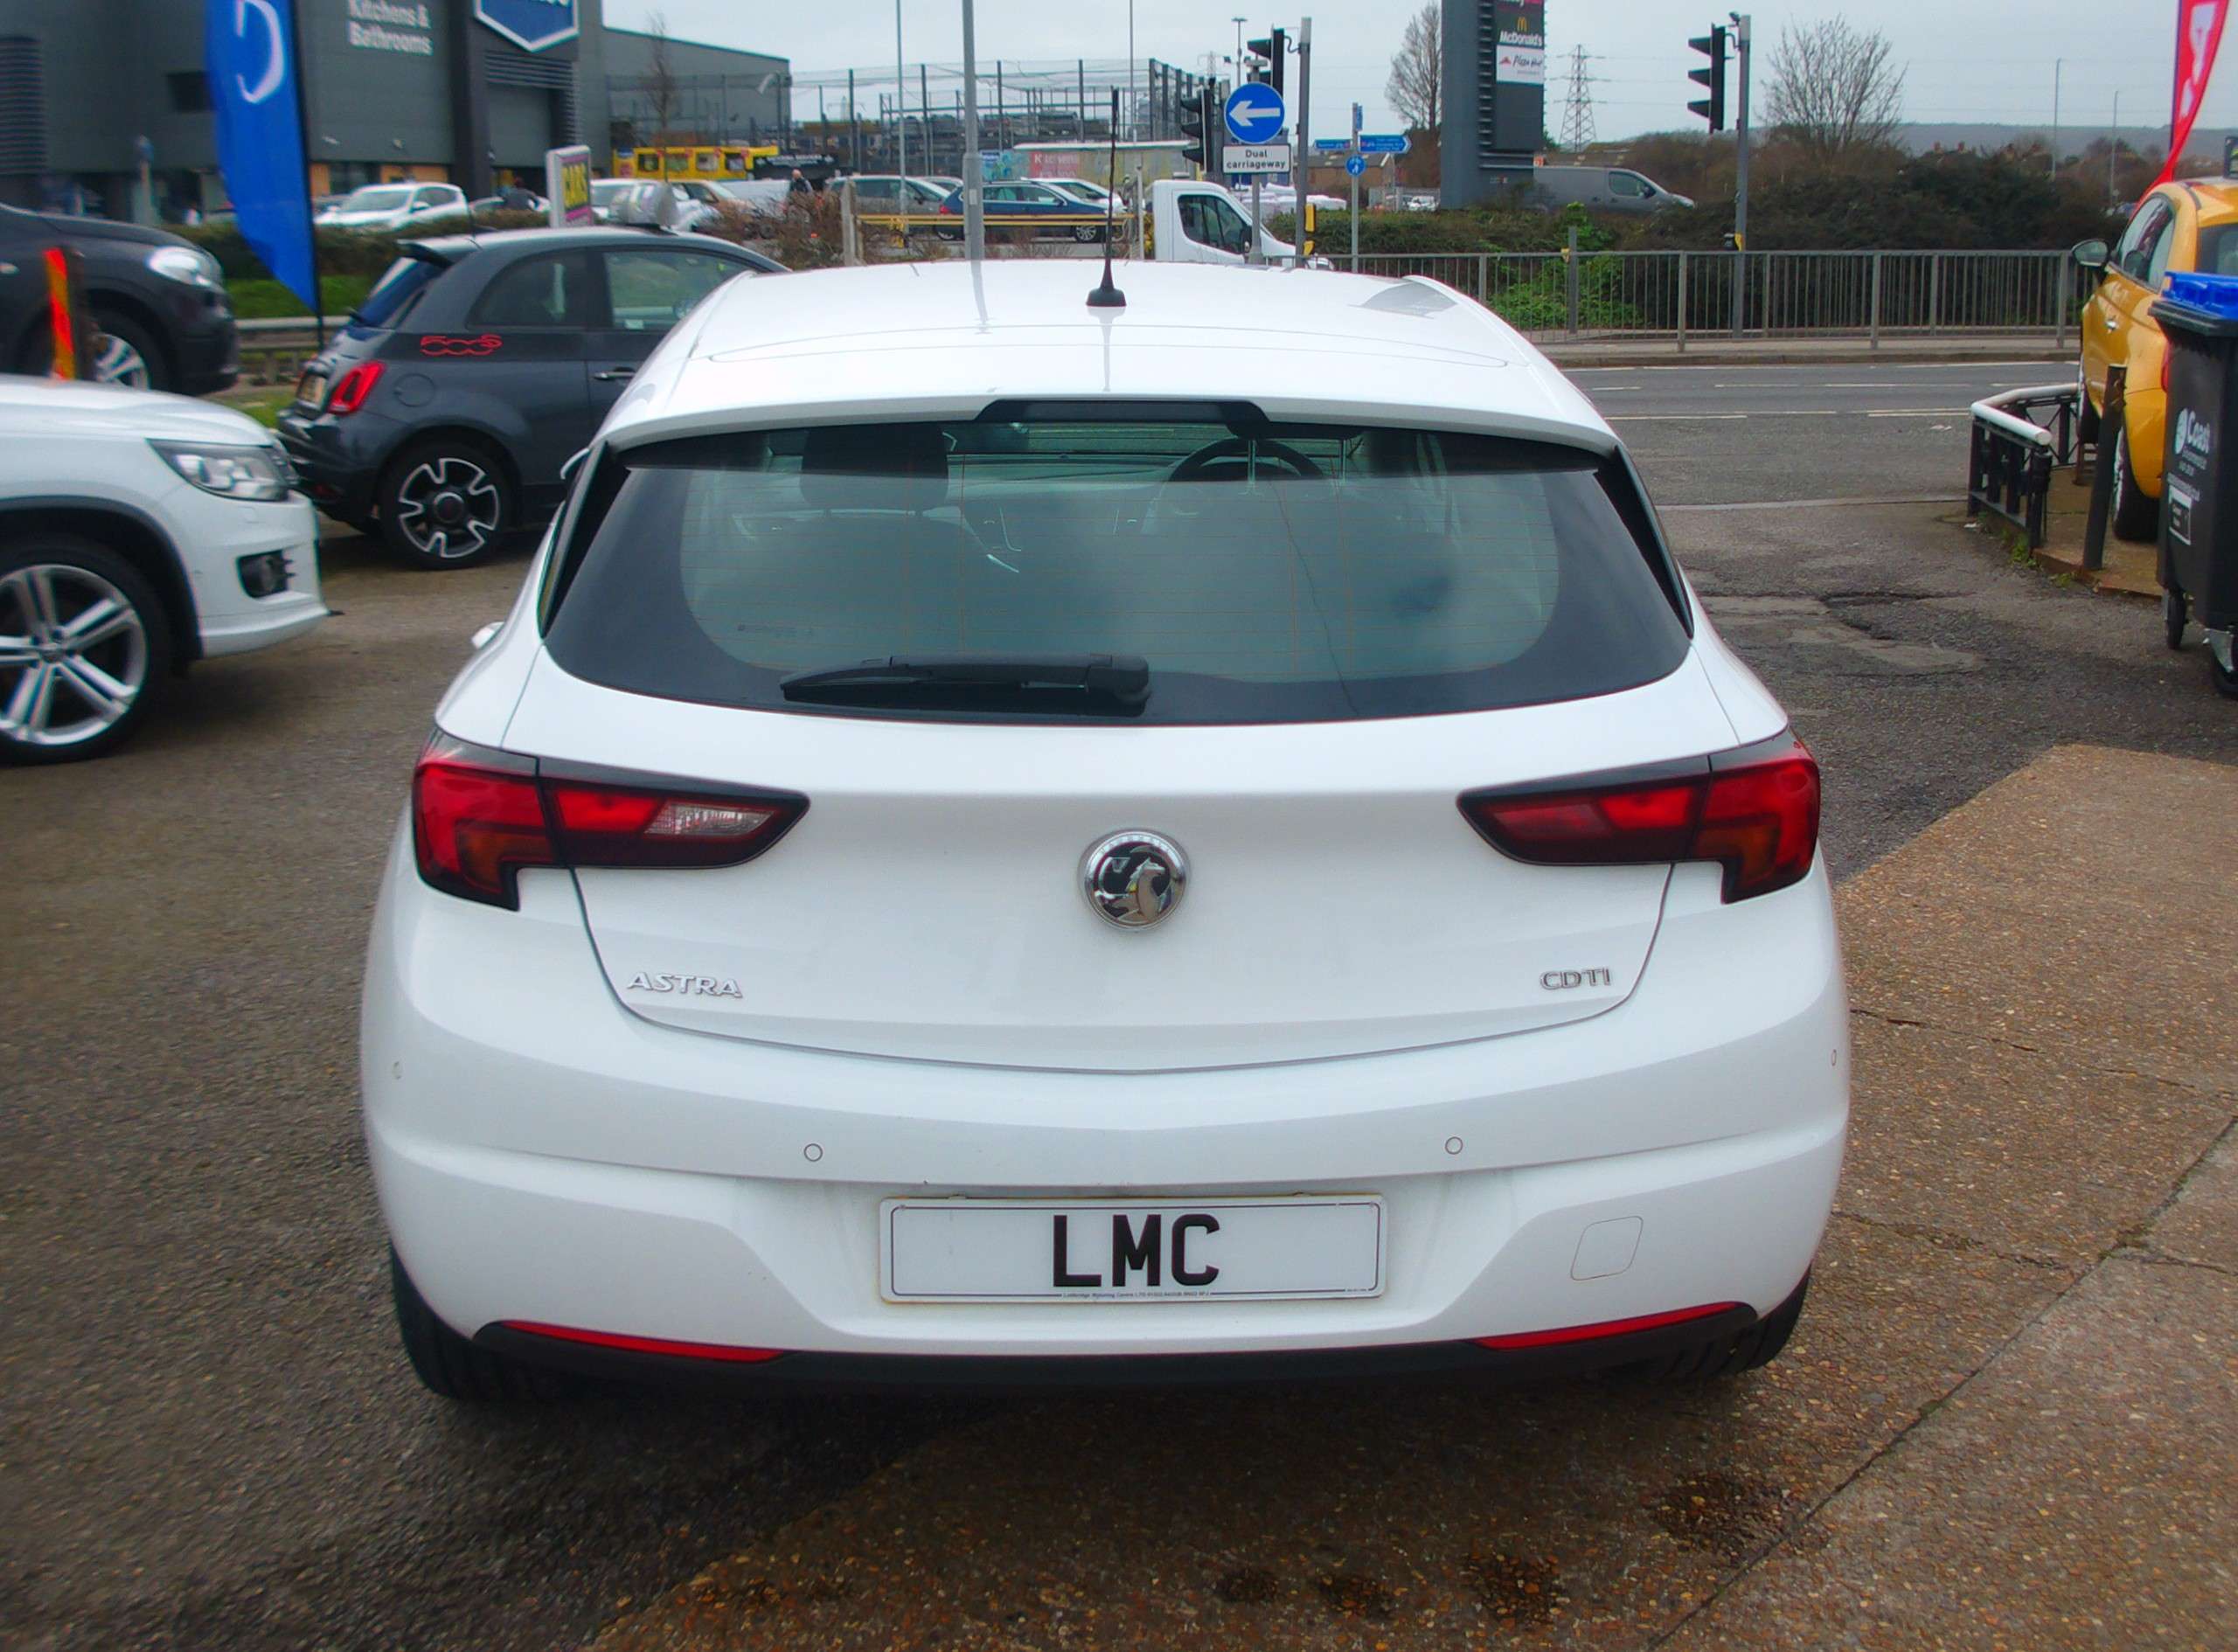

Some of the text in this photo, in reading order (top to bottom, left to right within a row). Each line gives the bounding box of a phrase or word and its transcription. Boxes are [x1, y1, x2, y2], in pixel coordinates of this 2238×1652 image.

[1499, 31, 1543, 46] McDonald's
[1245, 149, 1268, 158] Dual
[1226, 160, 1286, 170] carriageway
[627, 971, 743, 998] ASTRA
[1539, 967, 1611, 990] CDTI
[1053, 1214, 1220, 1287] LMC
